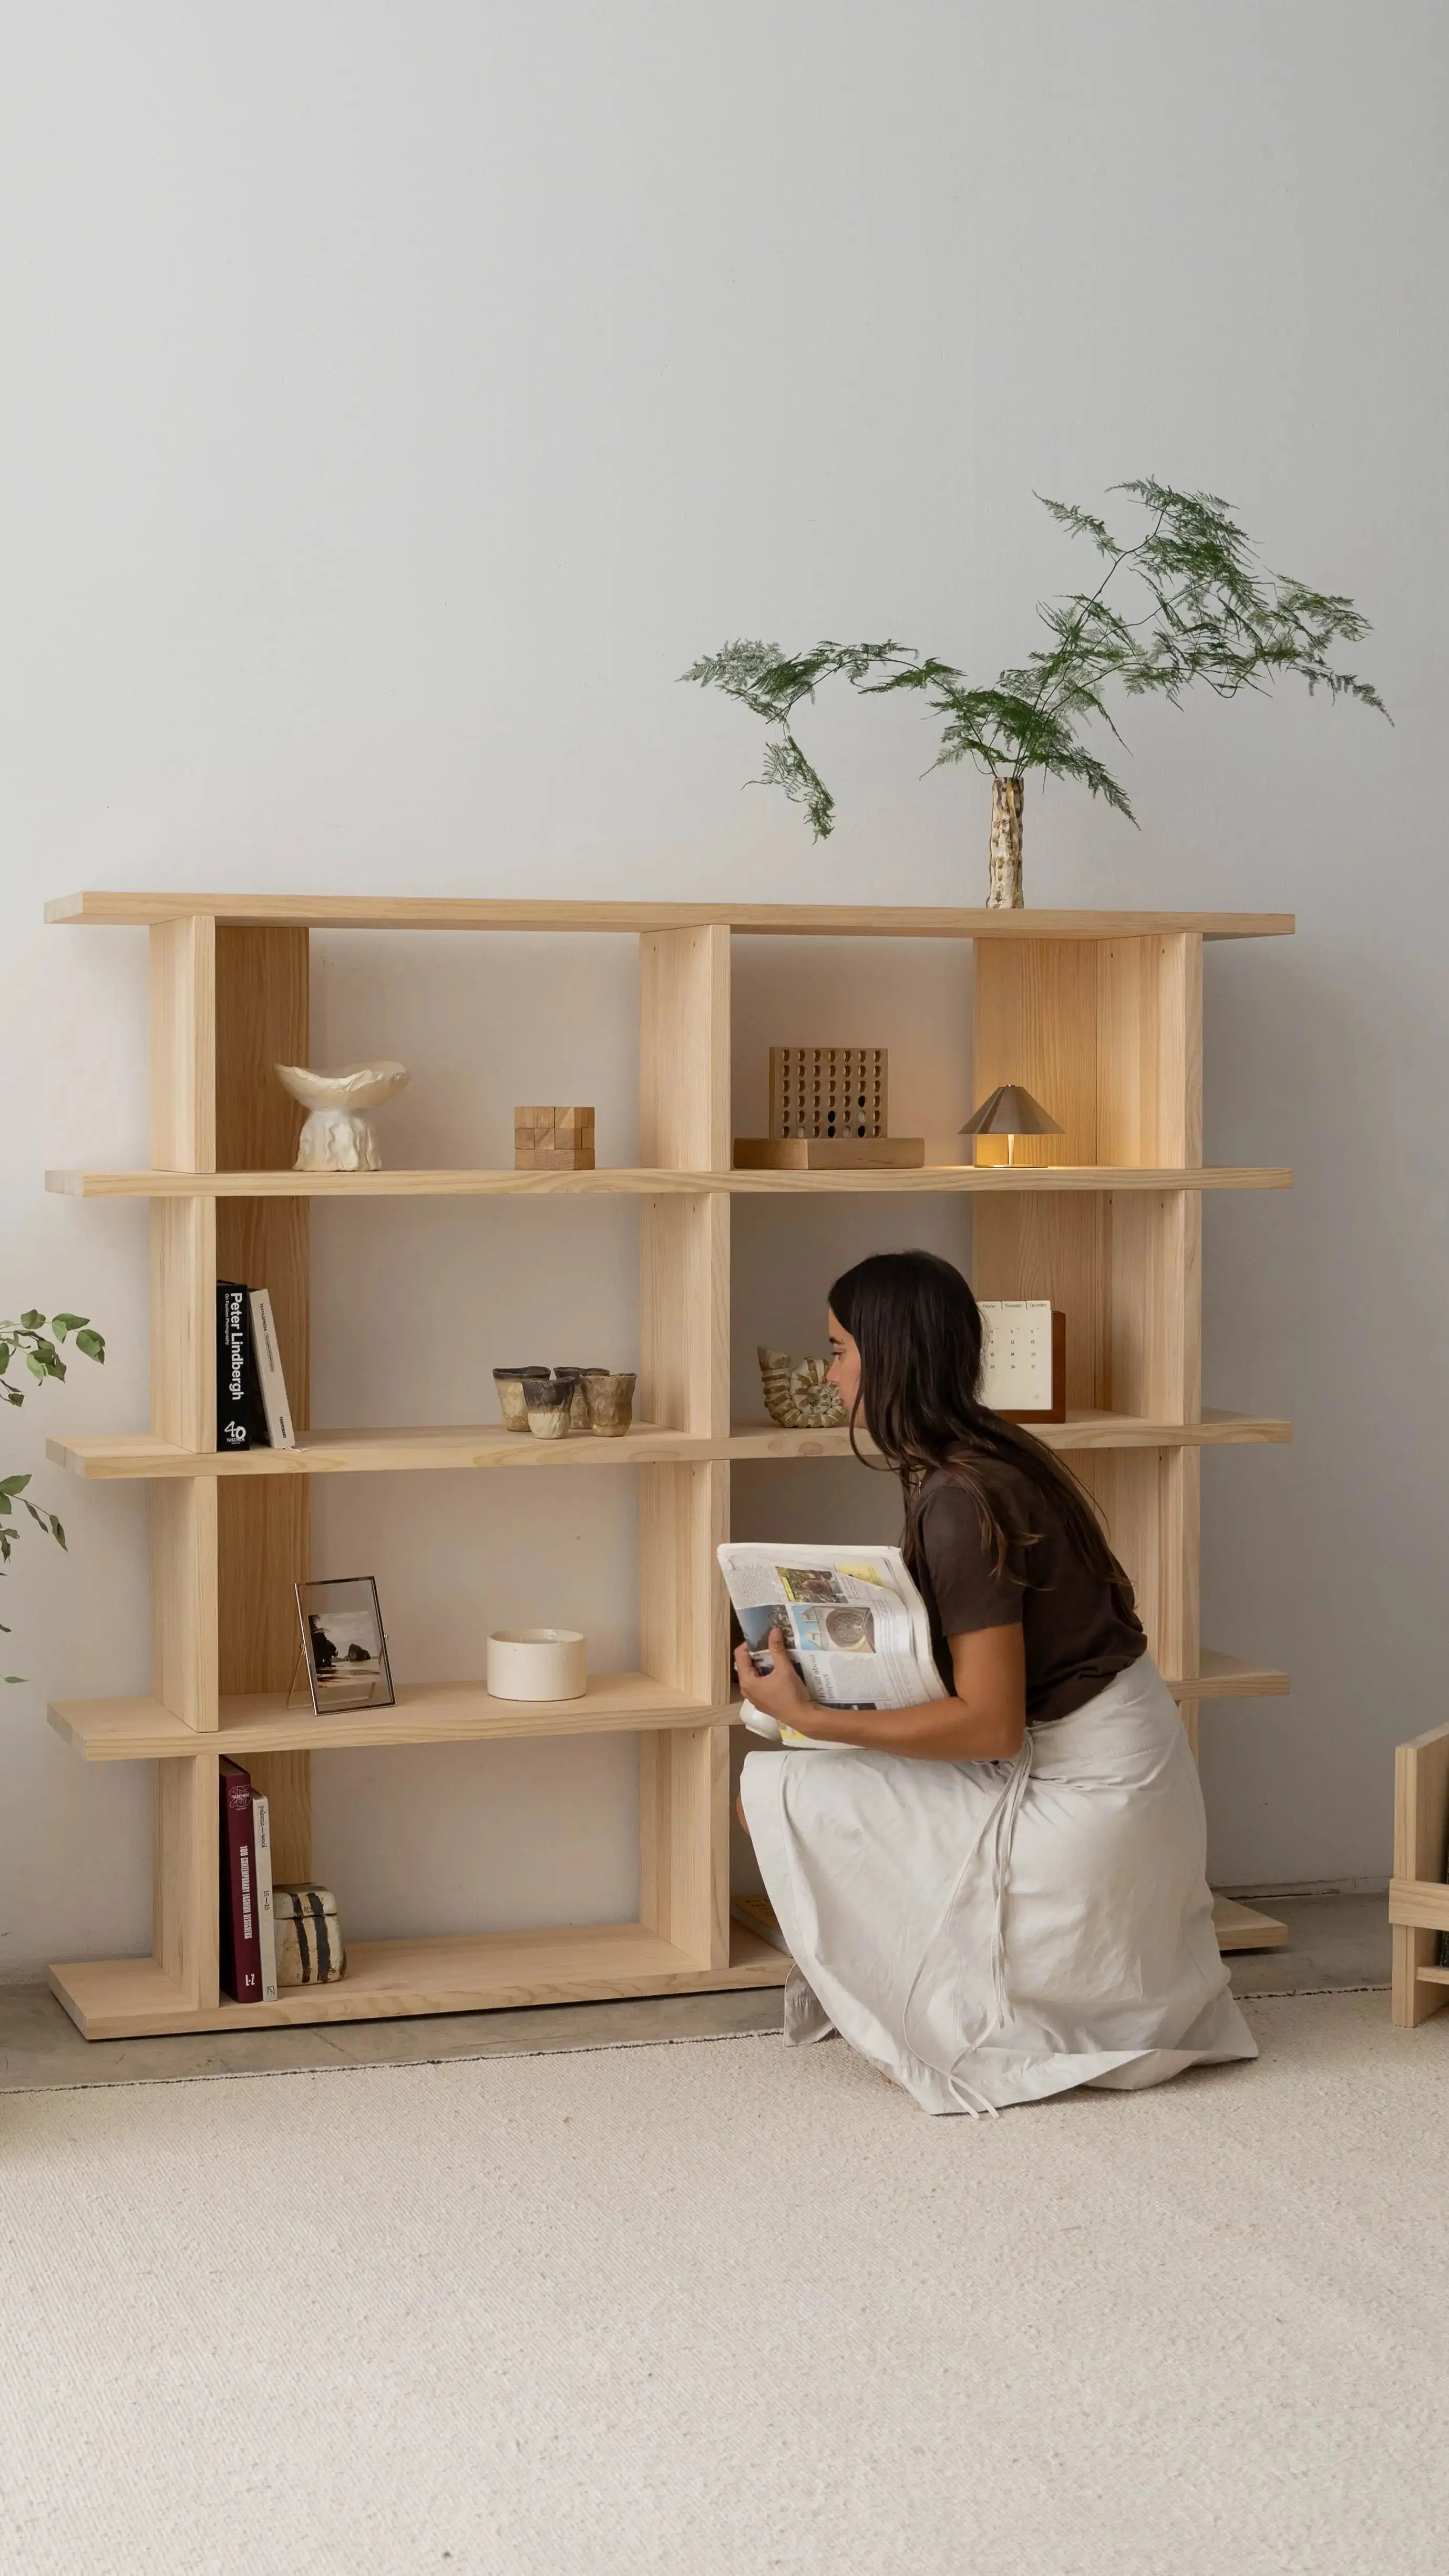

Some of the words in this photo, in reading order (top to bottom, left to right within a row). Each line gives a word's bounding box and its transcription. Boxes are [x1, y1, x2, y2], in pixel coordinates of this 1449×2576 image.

[230, 1293, 242, 1330] Peter
[229, 1333, 244, 1401] Lindbergh
[224, 1420, 246, 1438] 40
[809, 1654, 819, 1675] about
[823, 1674, 835, 1699] respect
[240, 1845, 248, 1856] 100
[240, 1857, 250, 1893] CONTEMPORARY
[242, 1894, 251, 1913] FASHION
[243, 1914, 252, 1939] DESIGNERS
